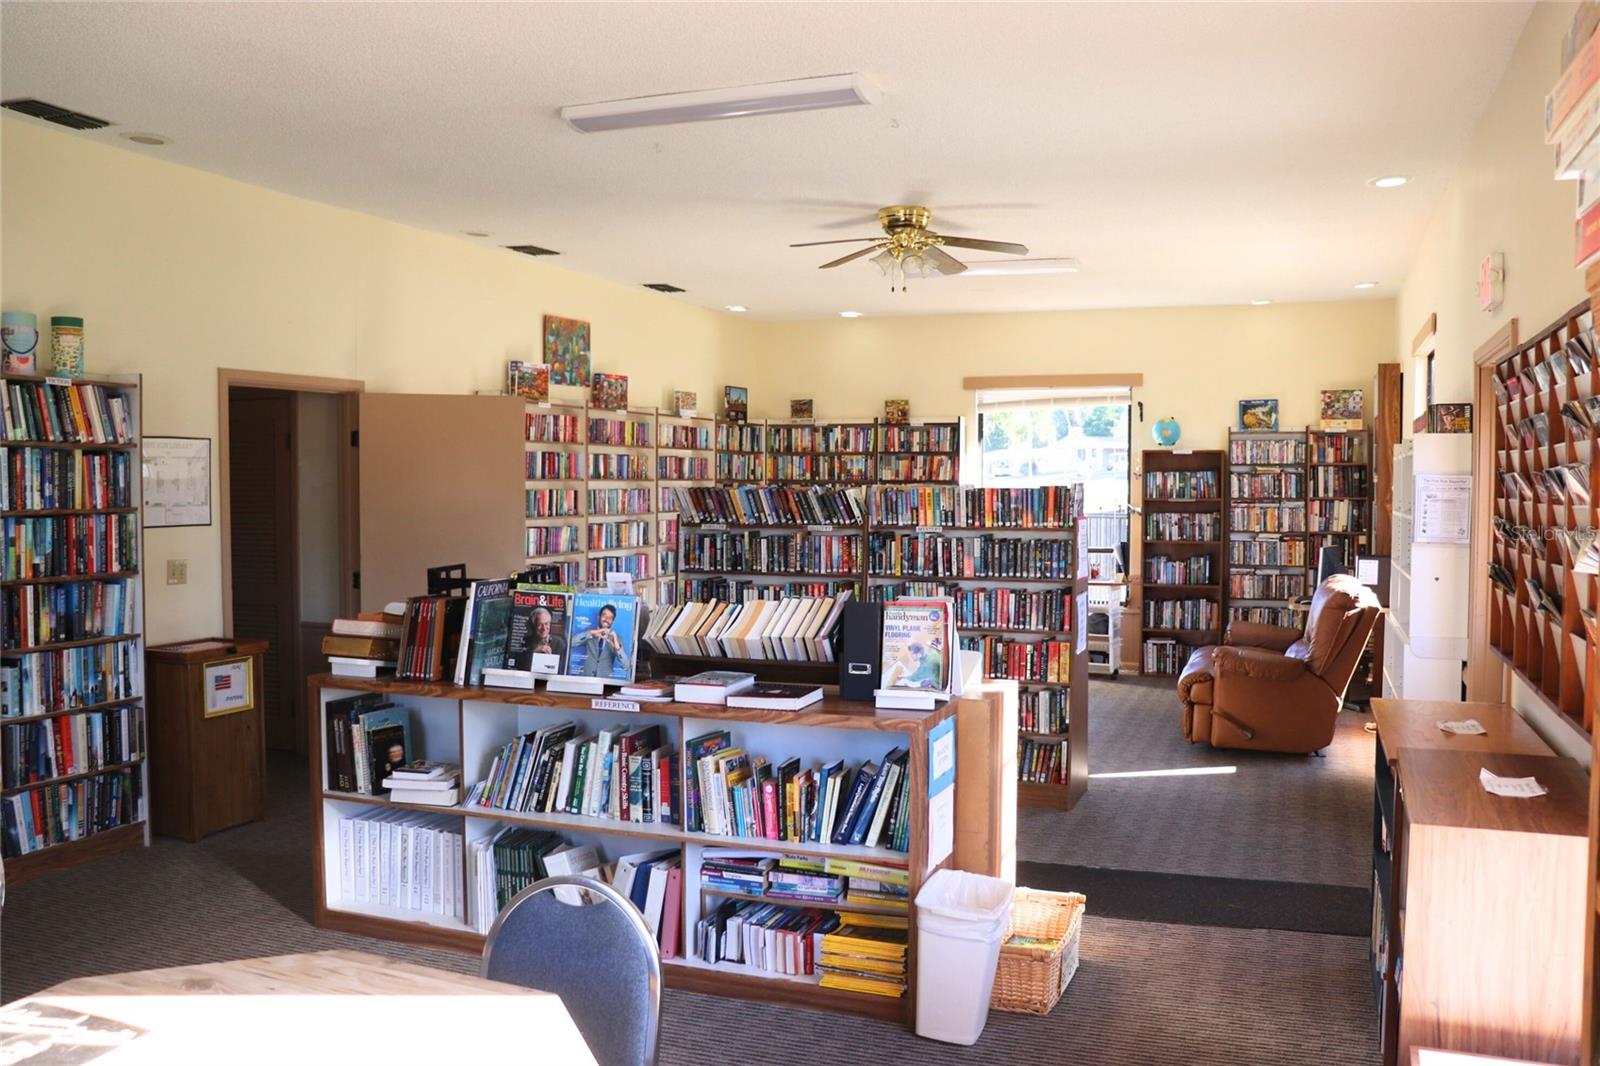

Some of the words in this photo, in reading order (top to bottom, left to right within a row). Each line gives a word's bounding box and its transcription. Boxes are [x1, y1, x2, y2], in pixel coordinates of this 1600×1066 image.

[514, 594, 564, 608] Brain&Life
[886, 611, 928, 622] handyman
[594, 700, 636, 710] REFERENCE
